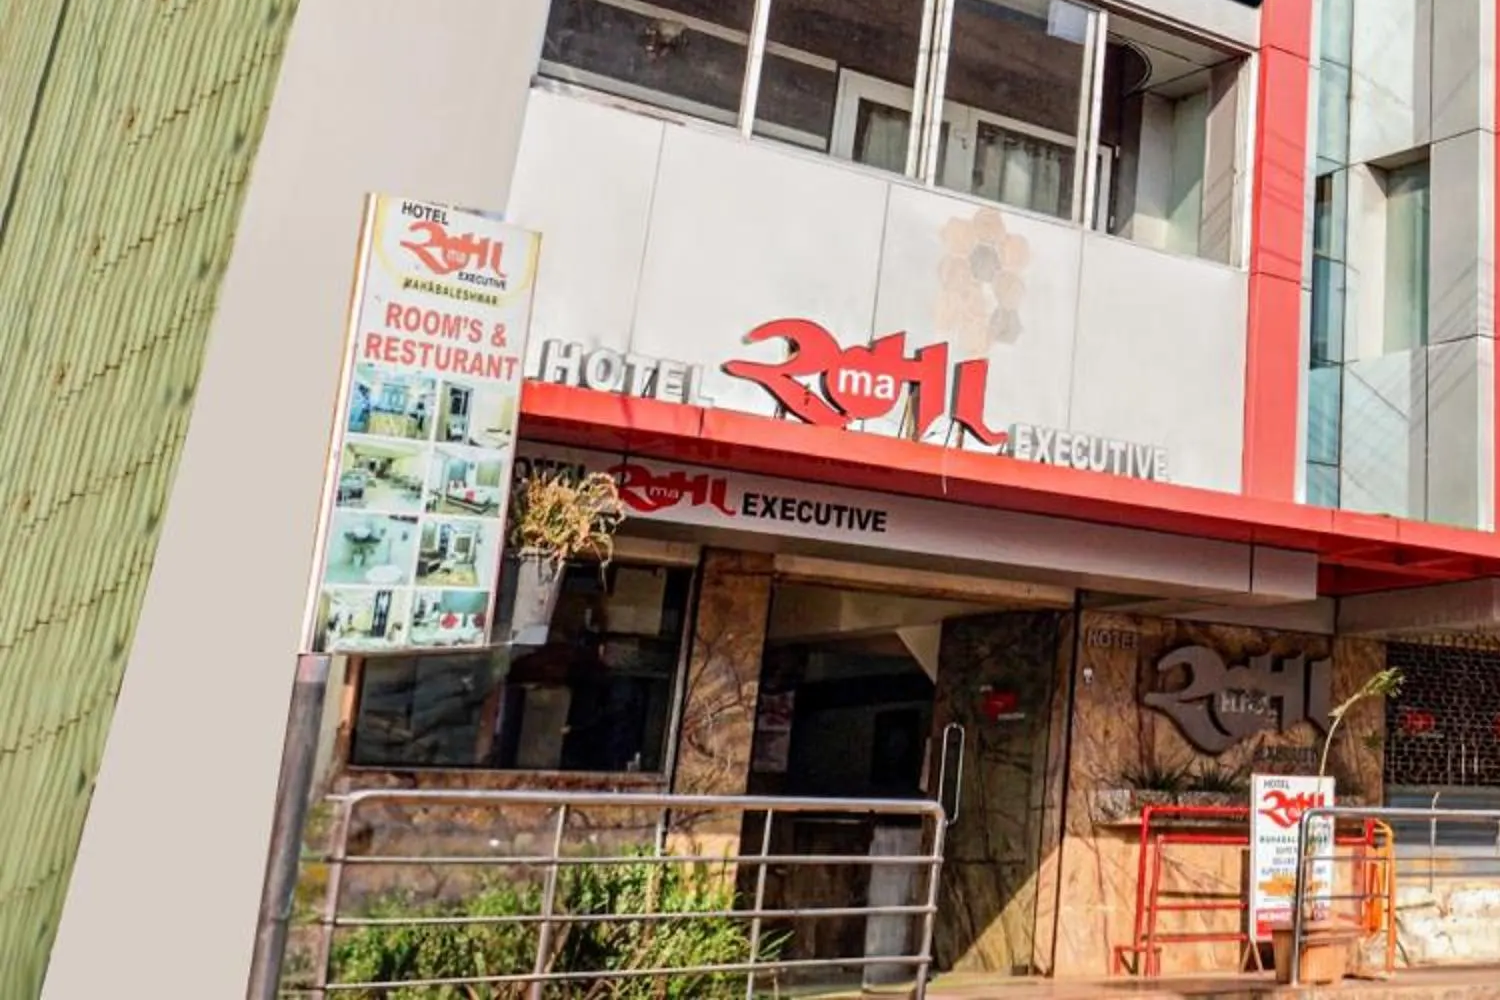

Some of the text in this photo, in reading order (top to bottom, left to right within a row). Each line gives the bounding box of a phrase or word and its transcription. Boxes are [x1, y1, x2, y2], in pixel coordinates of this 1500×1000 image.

[401, 200, 448, 226] HOTEL
[458, 271, 506, 290] EXECUTIVE
[385, 301, 506, 347] ROOM'S &
[364, 332, 519, 381] RESTURANT
[538, 338, 715, 407] HOTEL
[1010, 423, 1172, 483] EXECUTIVE
[742, 492, 888, 533] EXECUTIVE
